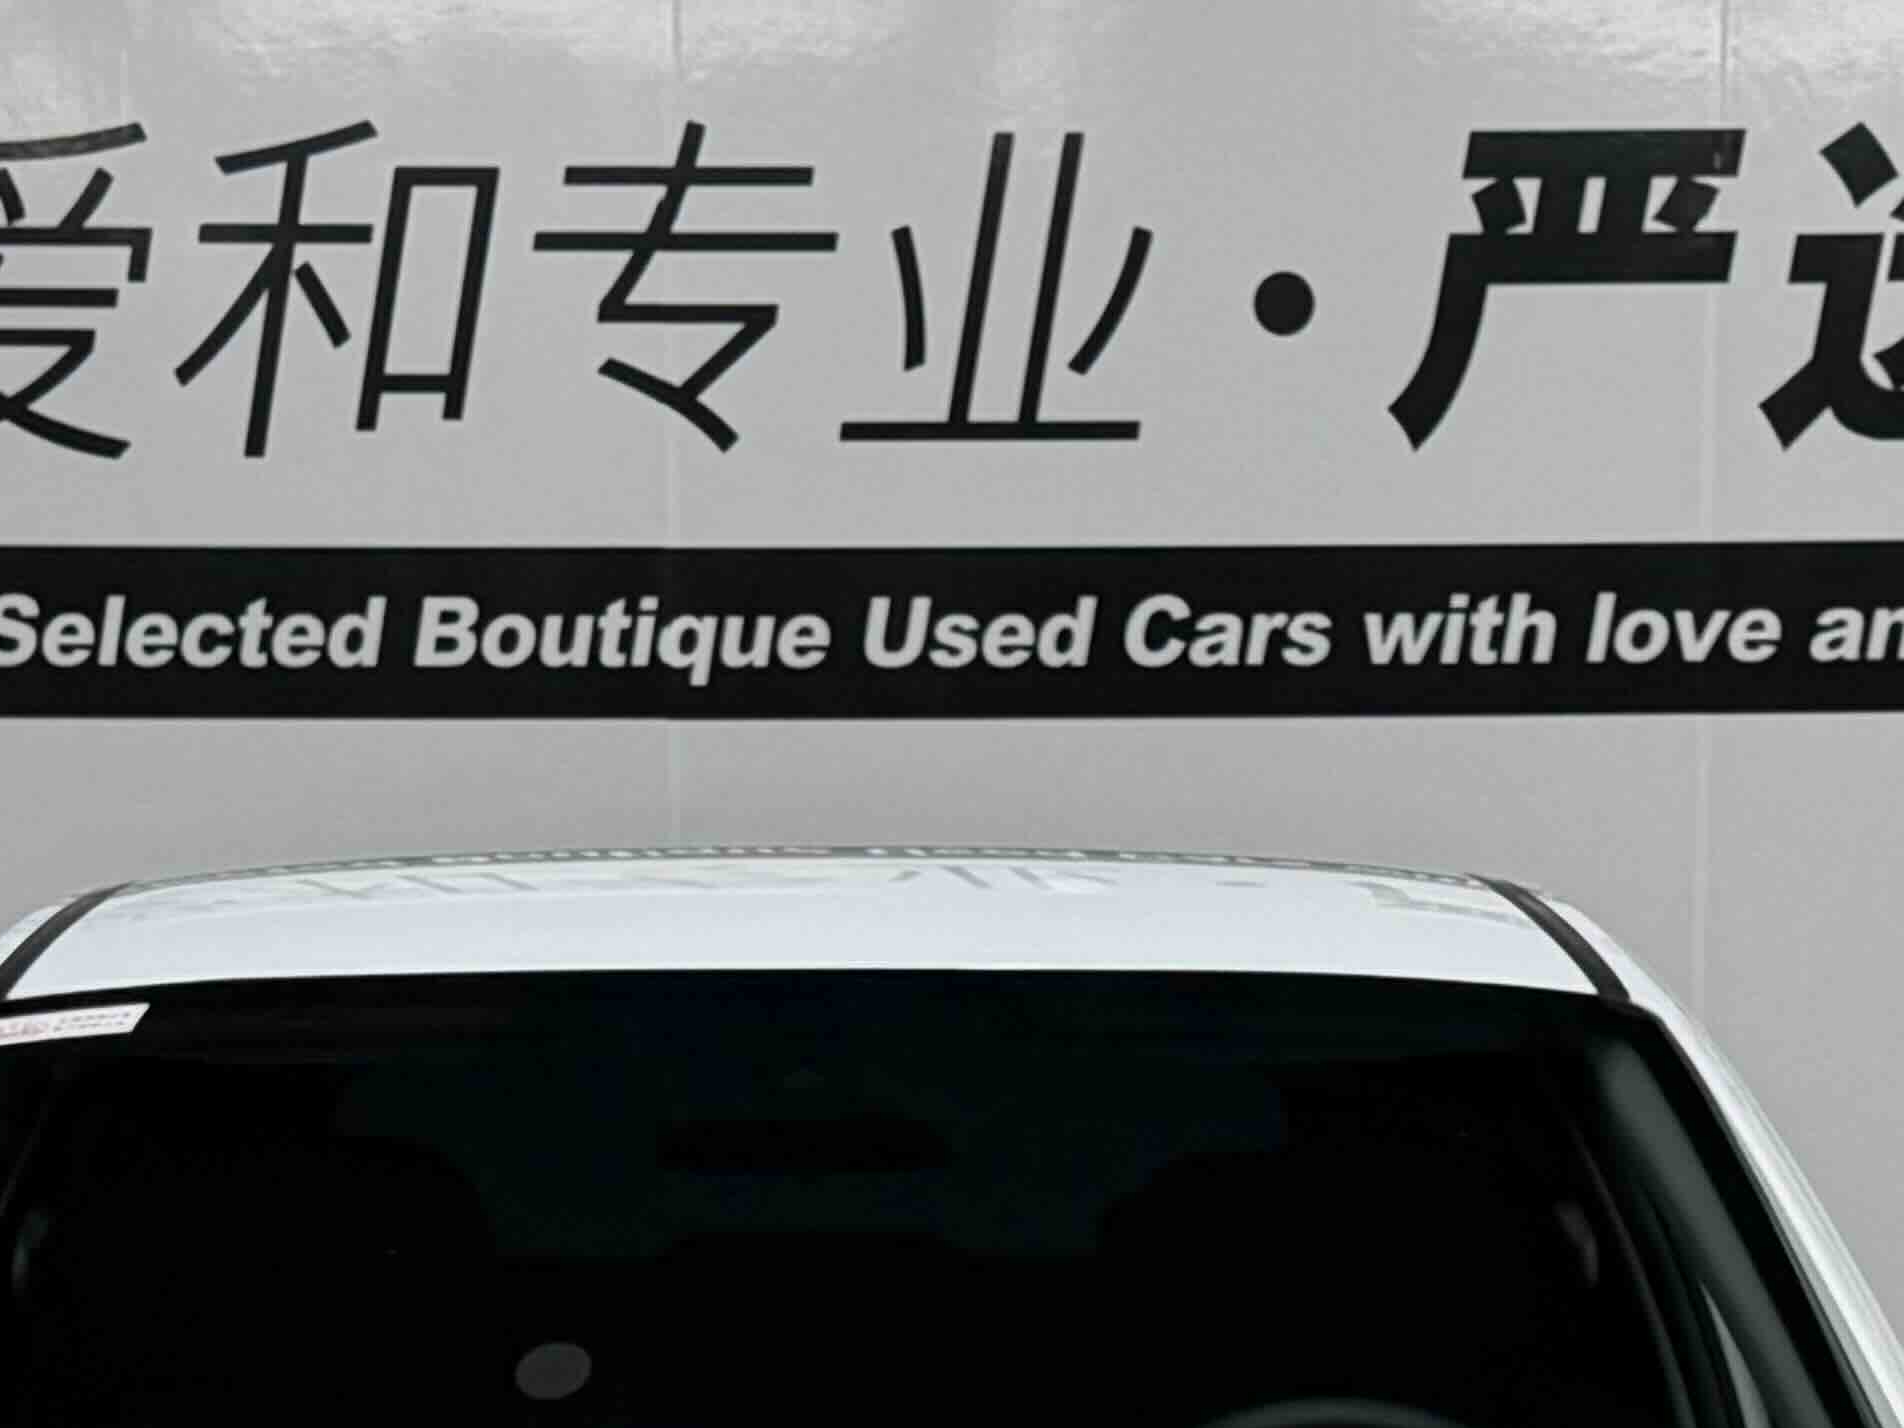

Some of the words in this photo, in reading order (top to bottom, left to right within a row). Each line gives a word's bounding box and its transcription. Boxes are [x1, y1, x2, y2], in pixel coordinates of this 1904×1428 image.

[414, 596, 832, 688] Boutique
[864, 595, 1098, 669] Used
[1124, 594, 1333, 668] Cars
[1364, 592, 1558, 666] with
[1586, 591, 1783, 664] love
